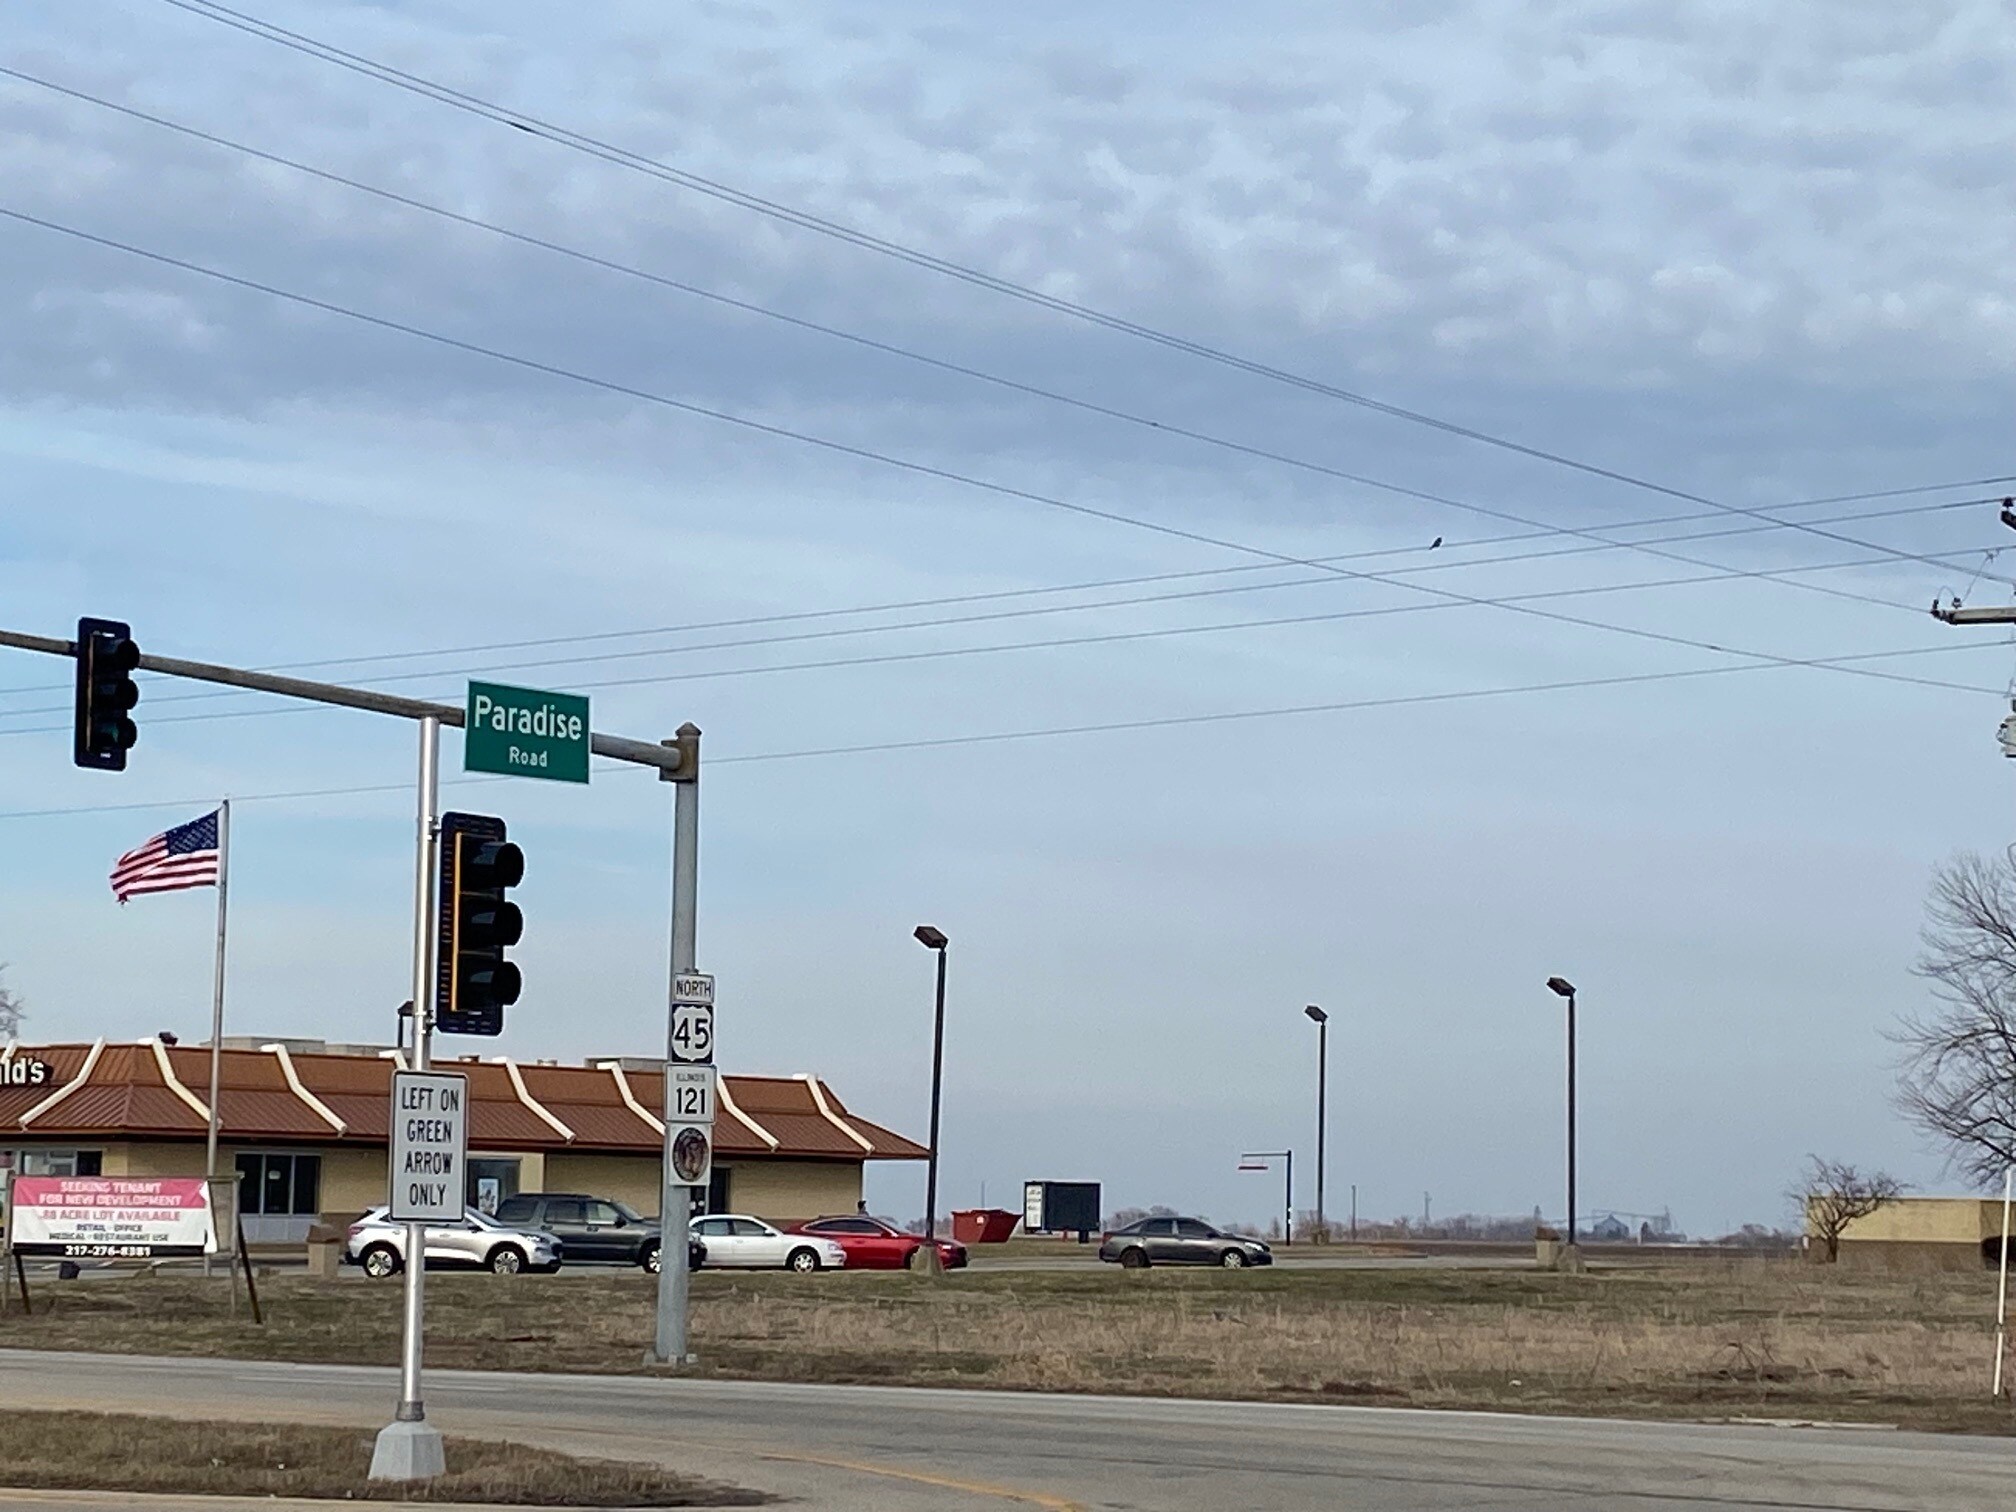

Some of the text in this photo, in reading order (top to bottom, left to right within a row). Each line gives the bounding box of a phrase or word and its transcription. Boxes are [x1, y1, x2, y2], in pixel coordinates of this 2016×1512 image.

[474, 695, 582, 740] Paradise
[509, 746, 547, 767] Road
[676, 980, 712, 996] NORTH
[674, 1017, 710, 1049] 45
[0, 1057, 44, 1084] ld's
[676, 1073, 706, 1082] ILLINOIS
[402, 1087, 460, 1111] LEFT ON
[676, 1087, 706, 1115] 121
[407, 1118, 453, 1143] GREEN
[404, 1151, 453, 1175] ARROW
[60, 1181, 162, 1194] SEEKING TENANT
[409, 1183, 447, 1206] ONLY
[39, 1193, 182, 1206] FOR NEW DEVELOPMENT
[60, 1210, 90, 1220] ACRE
[92, 1210, 115, 1220] LOT
[117, 1211, 181, 1221] AVAILABLE
[76, 1224, 143, 1232] RETAIL OFFICE
